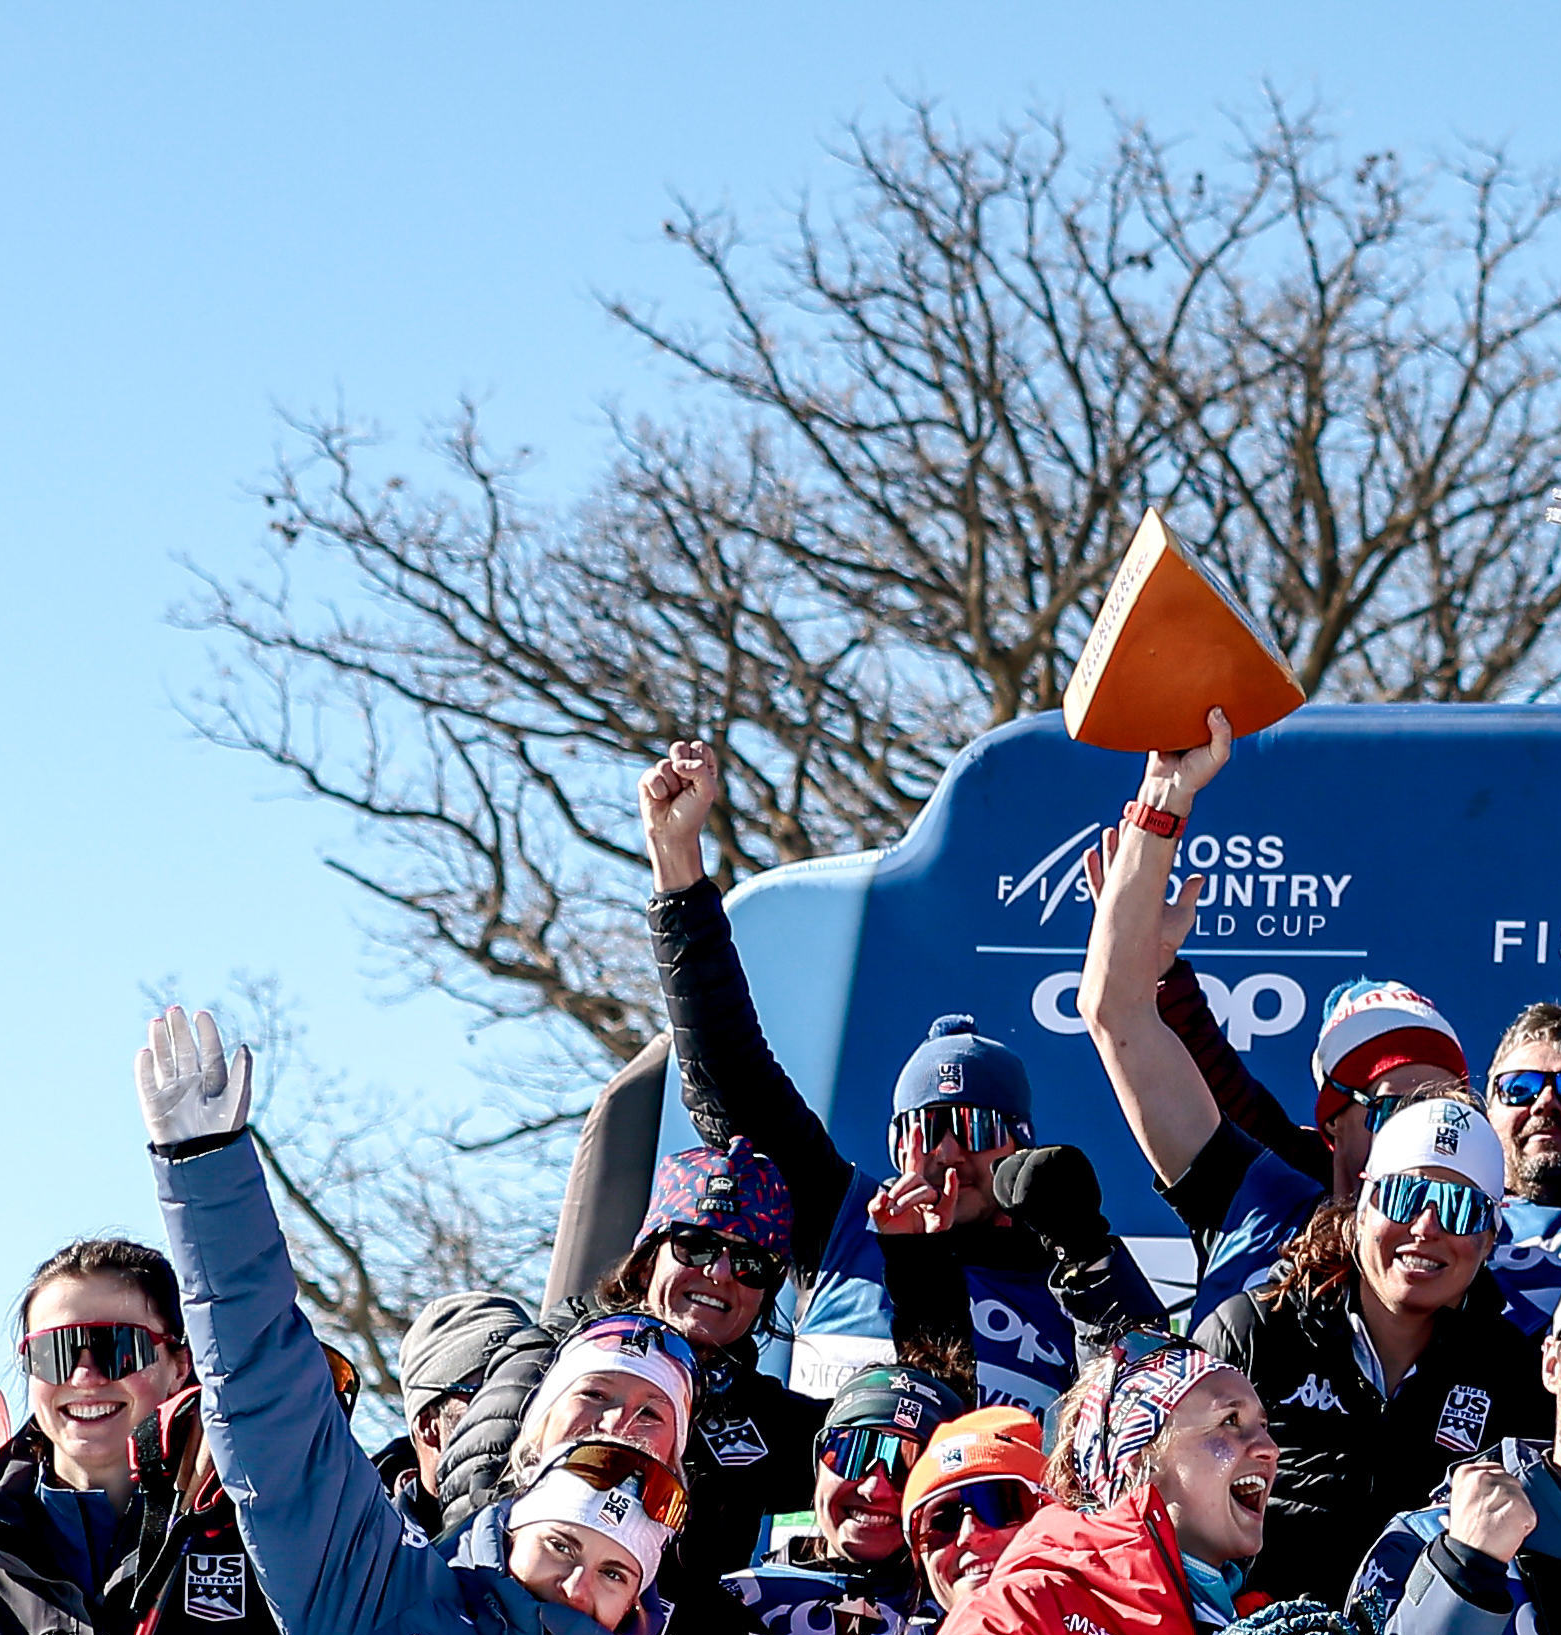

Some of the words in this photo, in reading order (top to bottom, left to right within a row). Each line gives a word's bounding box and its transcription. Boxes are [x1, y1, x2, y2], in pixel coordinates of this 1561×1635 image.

[998, 876, 1090, 903] FIS
[1447, 1391, 1490, 1416] US
[608, 1491, 631, 1511] US
[189, 1555, 242, 1576] US
